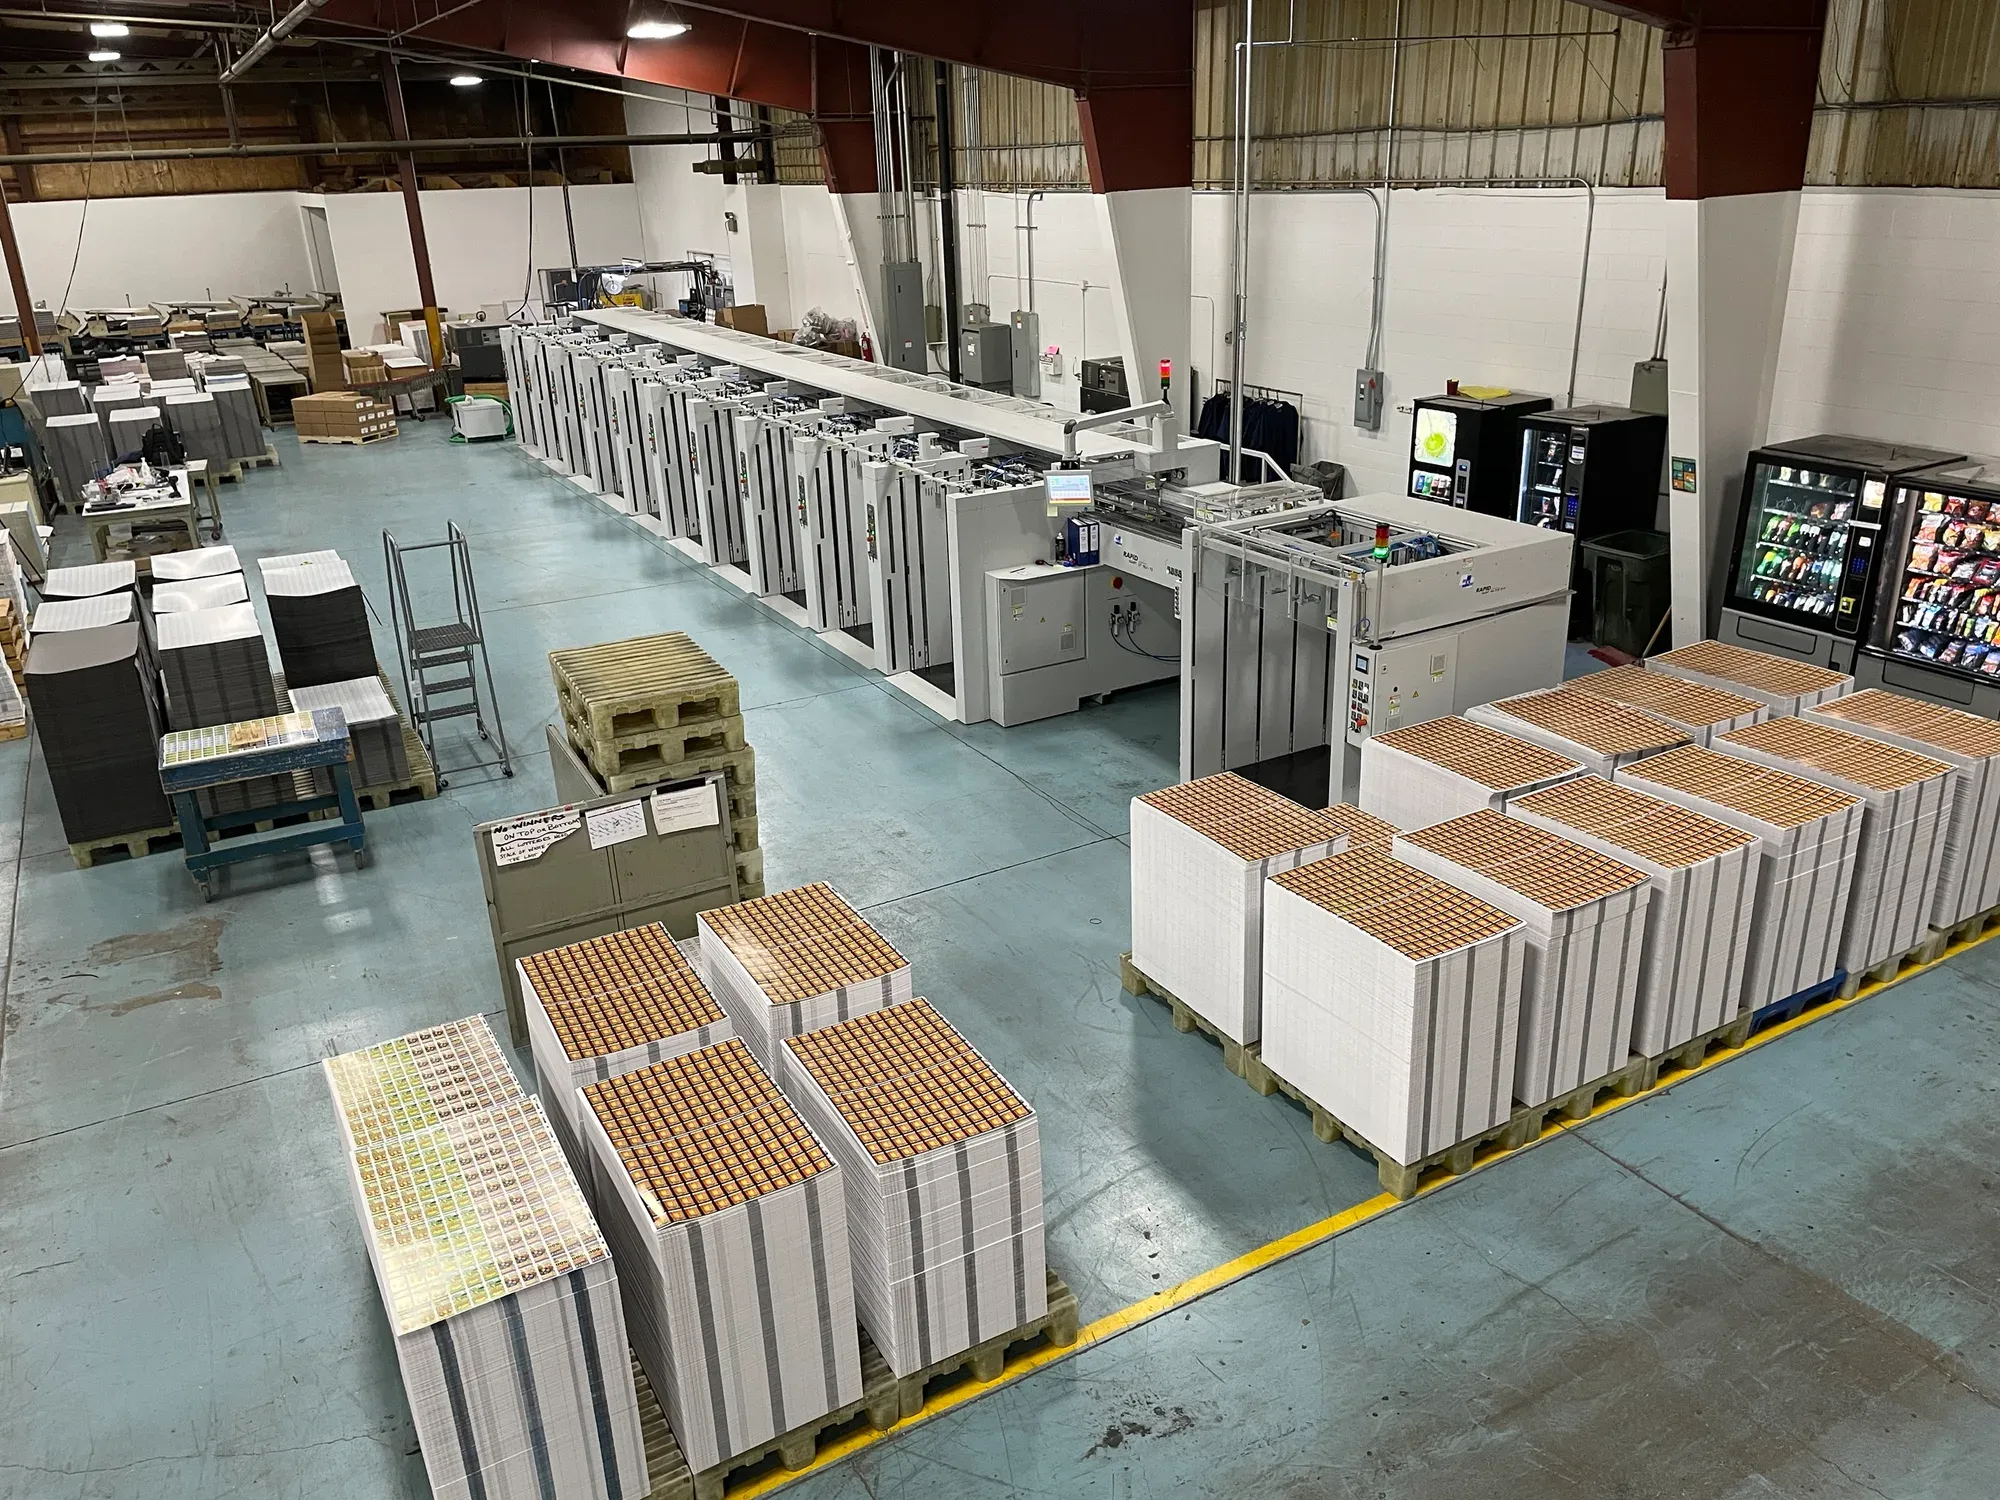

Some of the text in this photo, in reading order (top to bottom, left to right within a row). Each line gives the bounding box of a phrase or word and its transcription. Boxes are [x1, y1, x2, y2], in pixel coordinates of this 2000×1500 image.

[1123, 551, 1139, 561] RAPID
[512, 814, 566, 829] WINNERS
[503, 832, 515, 841] ON
[516, 828, 535, 838] TOP
[500, 845, 514, 853] ALL
[517, 836, 551, 847] LOTTERIES
